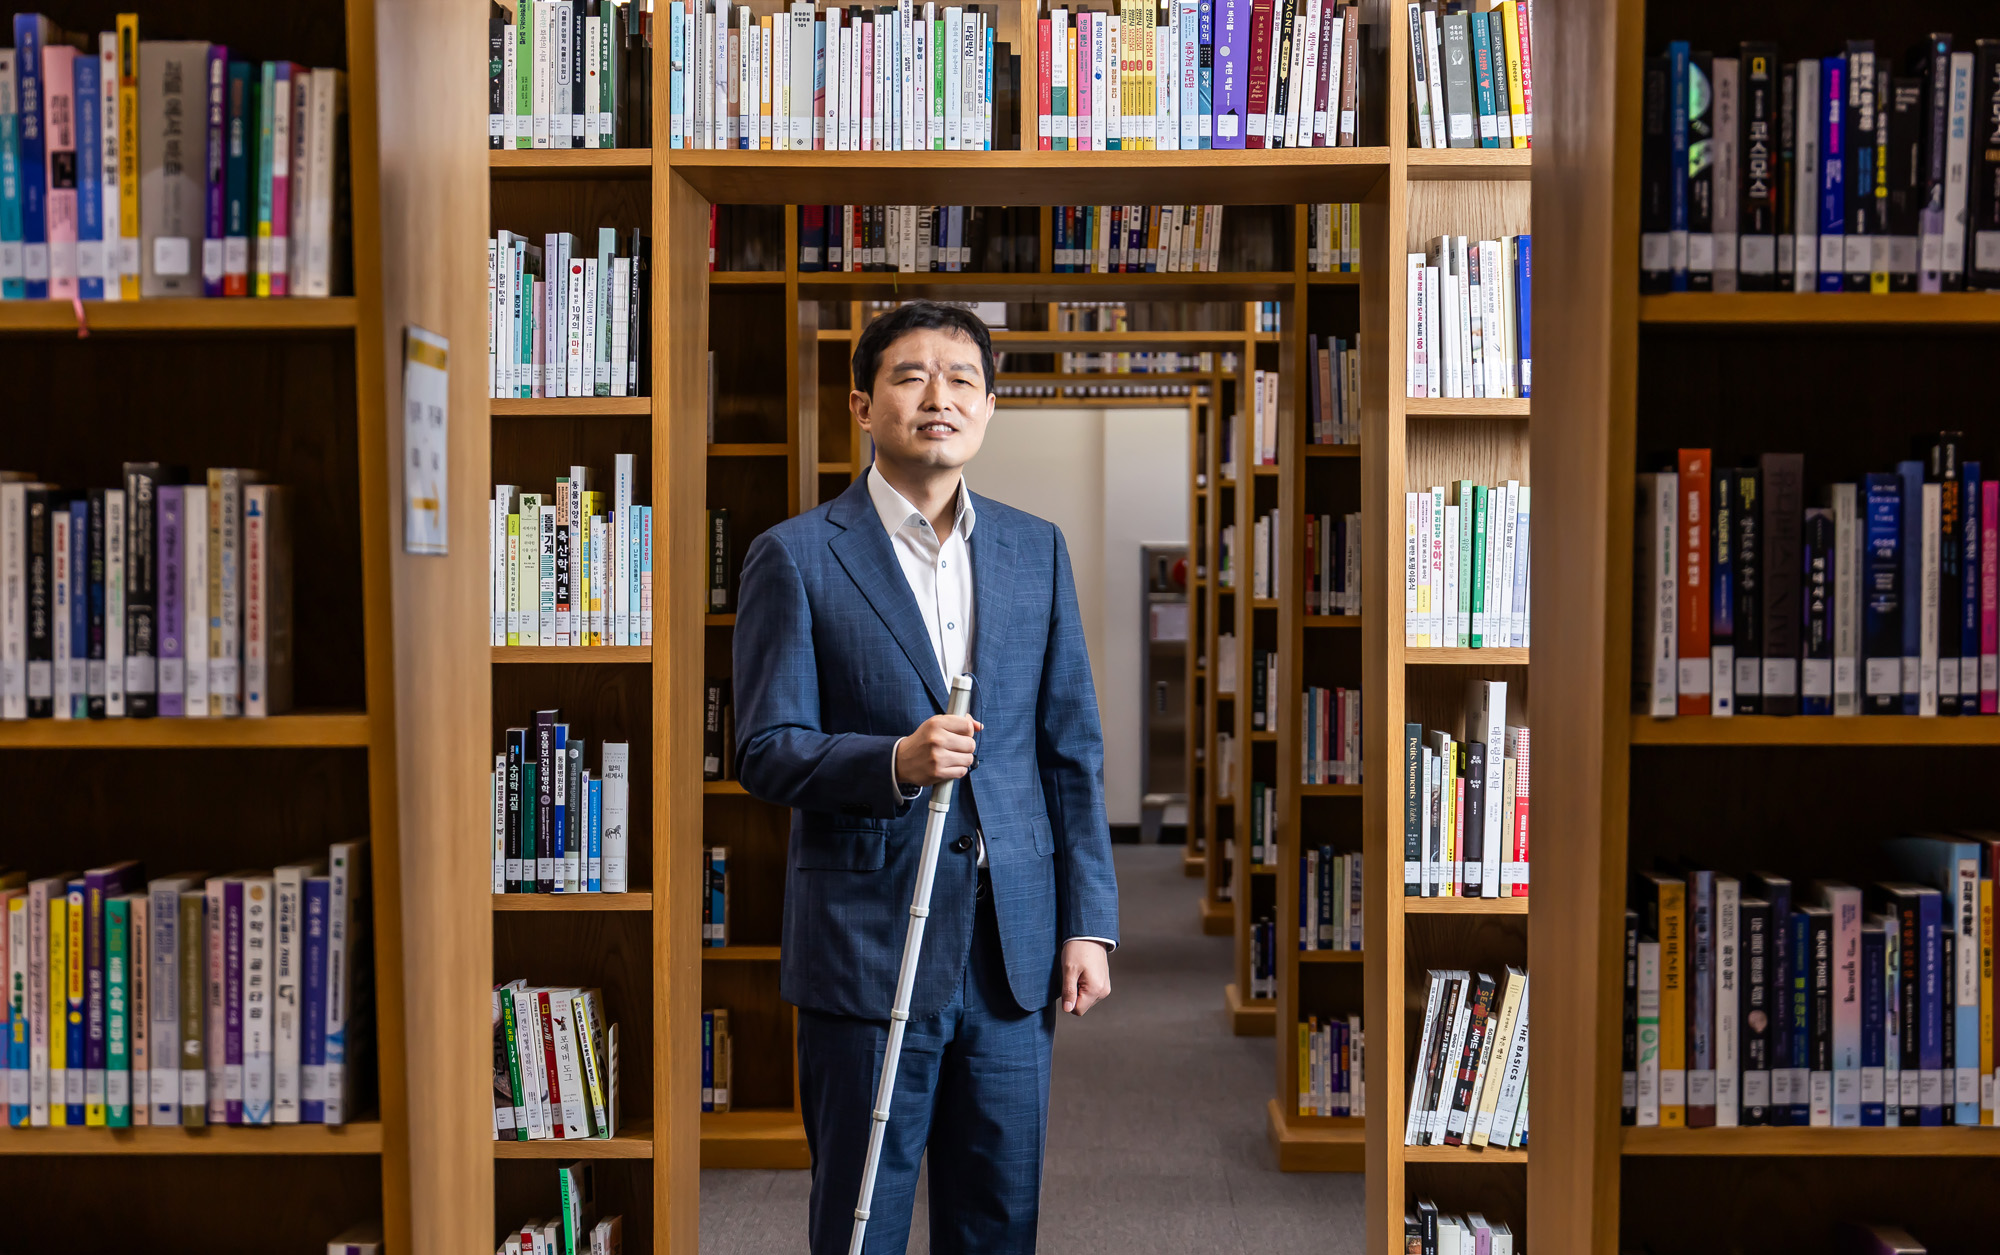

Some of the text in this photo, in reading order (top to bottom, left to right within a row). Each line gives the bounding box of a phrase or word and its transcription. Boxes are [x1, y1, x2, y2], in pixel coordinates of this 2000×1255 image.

[1226, 10, 1234, 31] 바이블
[1323, 20, 1331, 42] 소믈리에
[965, 25, 974, 57] 타임박싱
[571, 331, 580, 355] 토마토
[542, 555, 554, 581] ANIMAL
[557, 530, 569, 599] 축산학개론
[1409, 737, 1418, 761] Petits
[1488, 726, 1502, 790] 대통령의 식탁
[1409, 761, 1417, 800] Moments
[1475, 991, 1489, 1027] SEARED
[1509, 1023, 1529, 1081] THE BASICS
